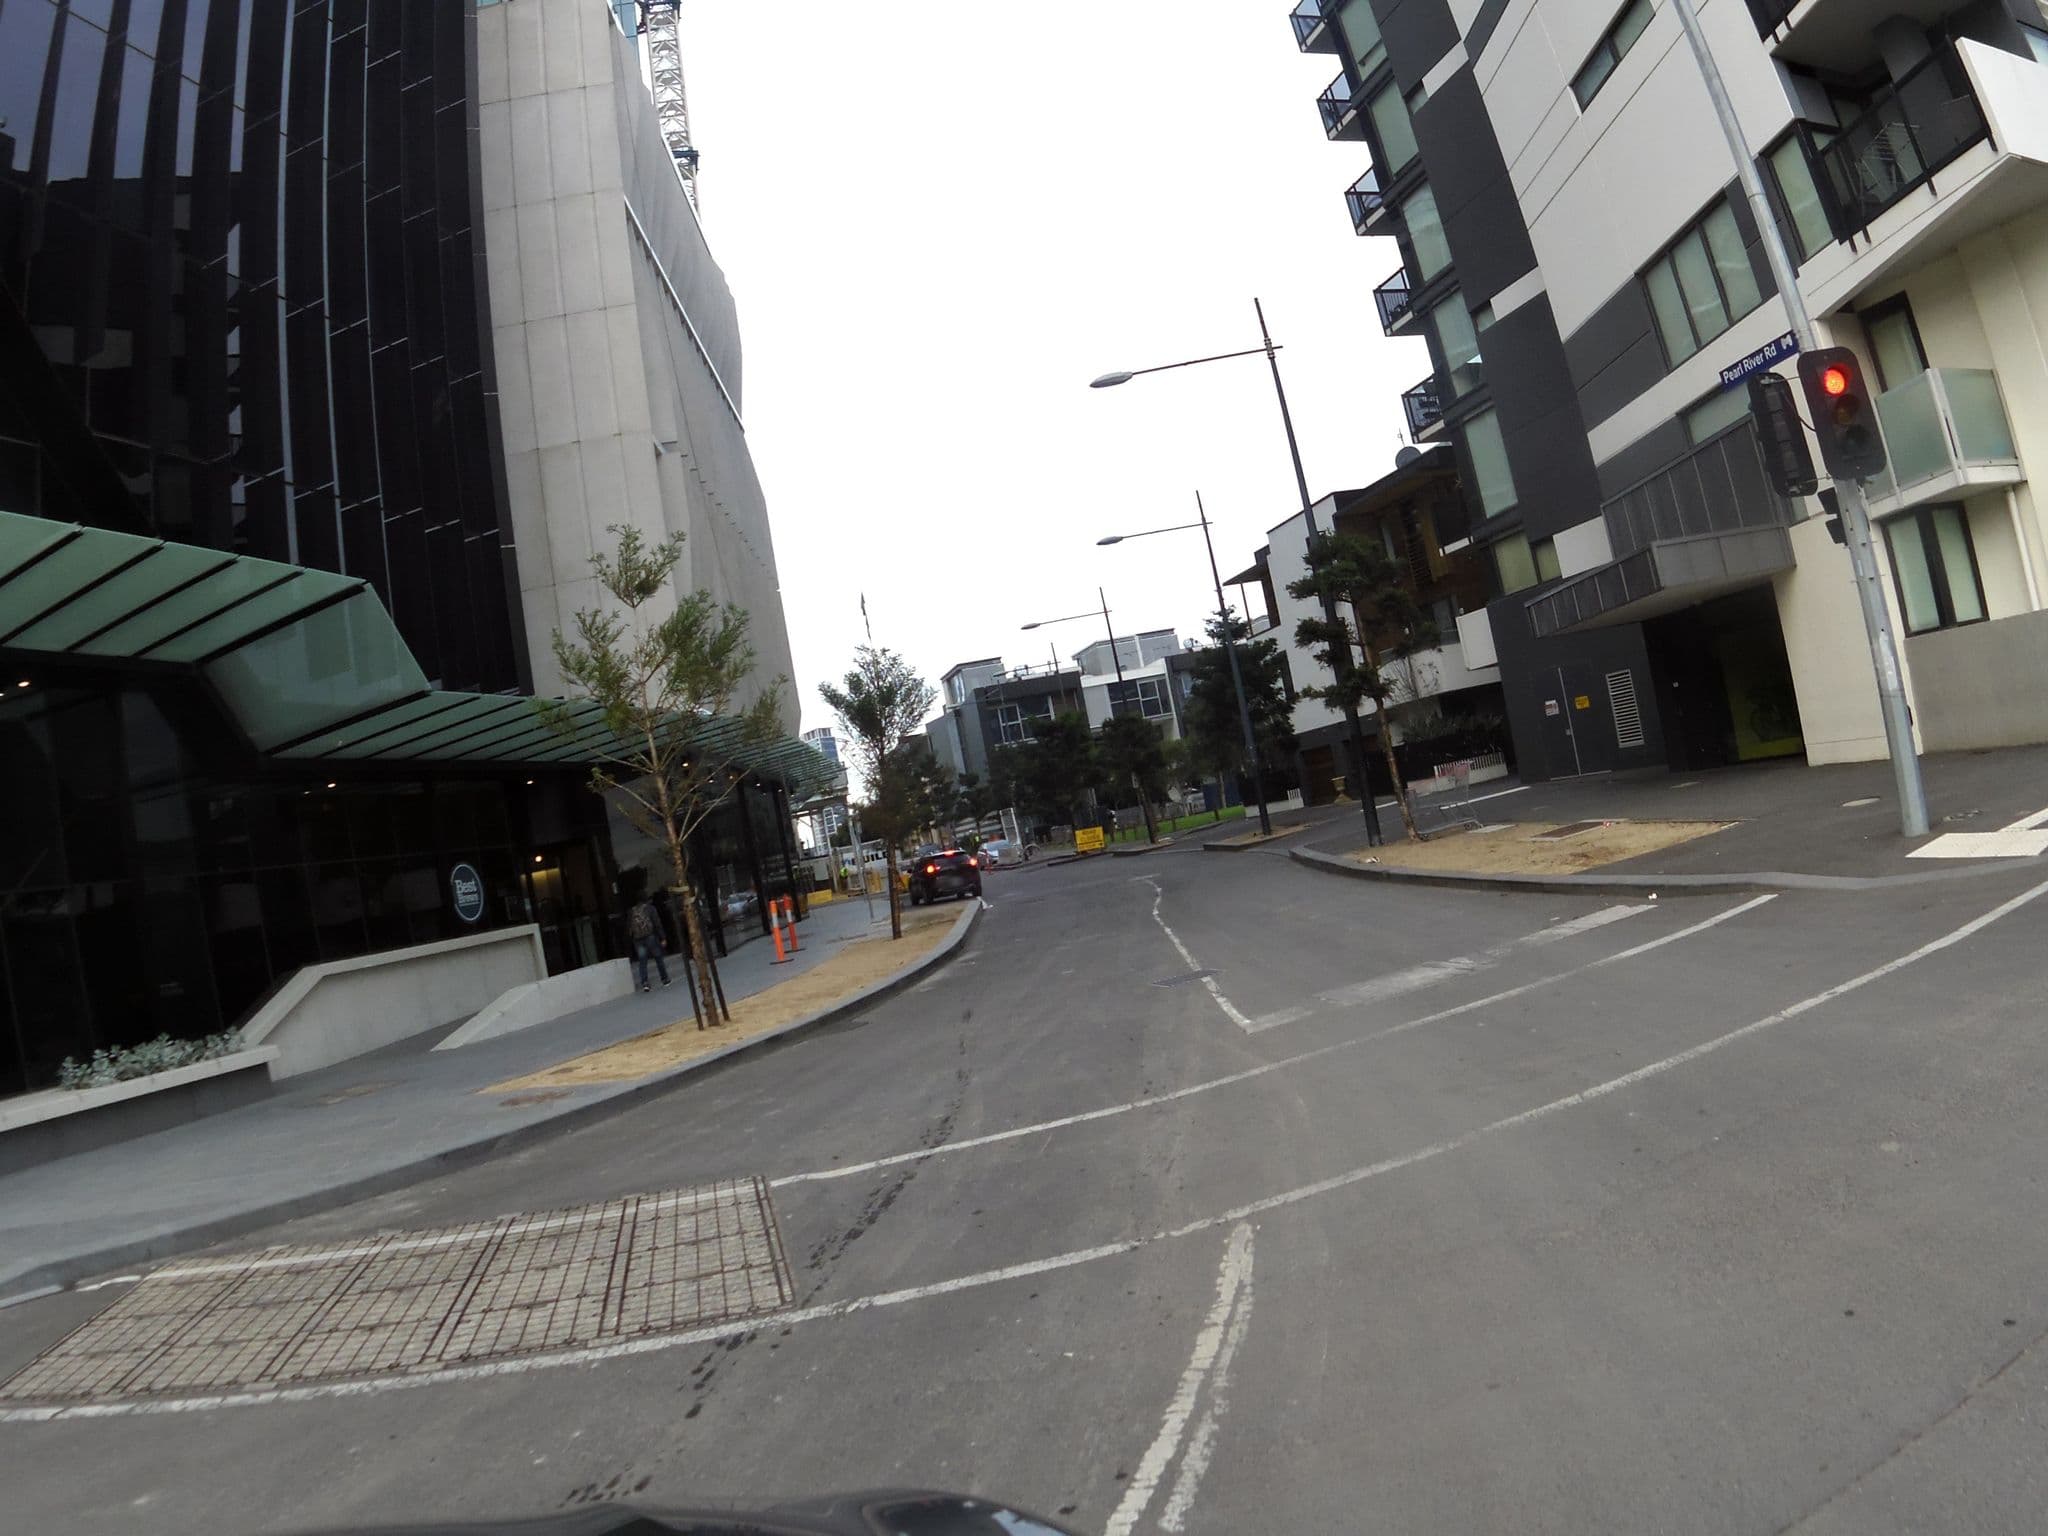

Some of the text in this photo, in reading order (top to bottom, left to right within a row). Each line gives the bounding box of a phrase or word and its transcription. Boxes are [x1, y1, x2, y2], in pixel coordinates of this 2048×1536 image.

[1722, 343, 1777, 384] Pearl River Rd
[455, 878, 477, 894] Best
